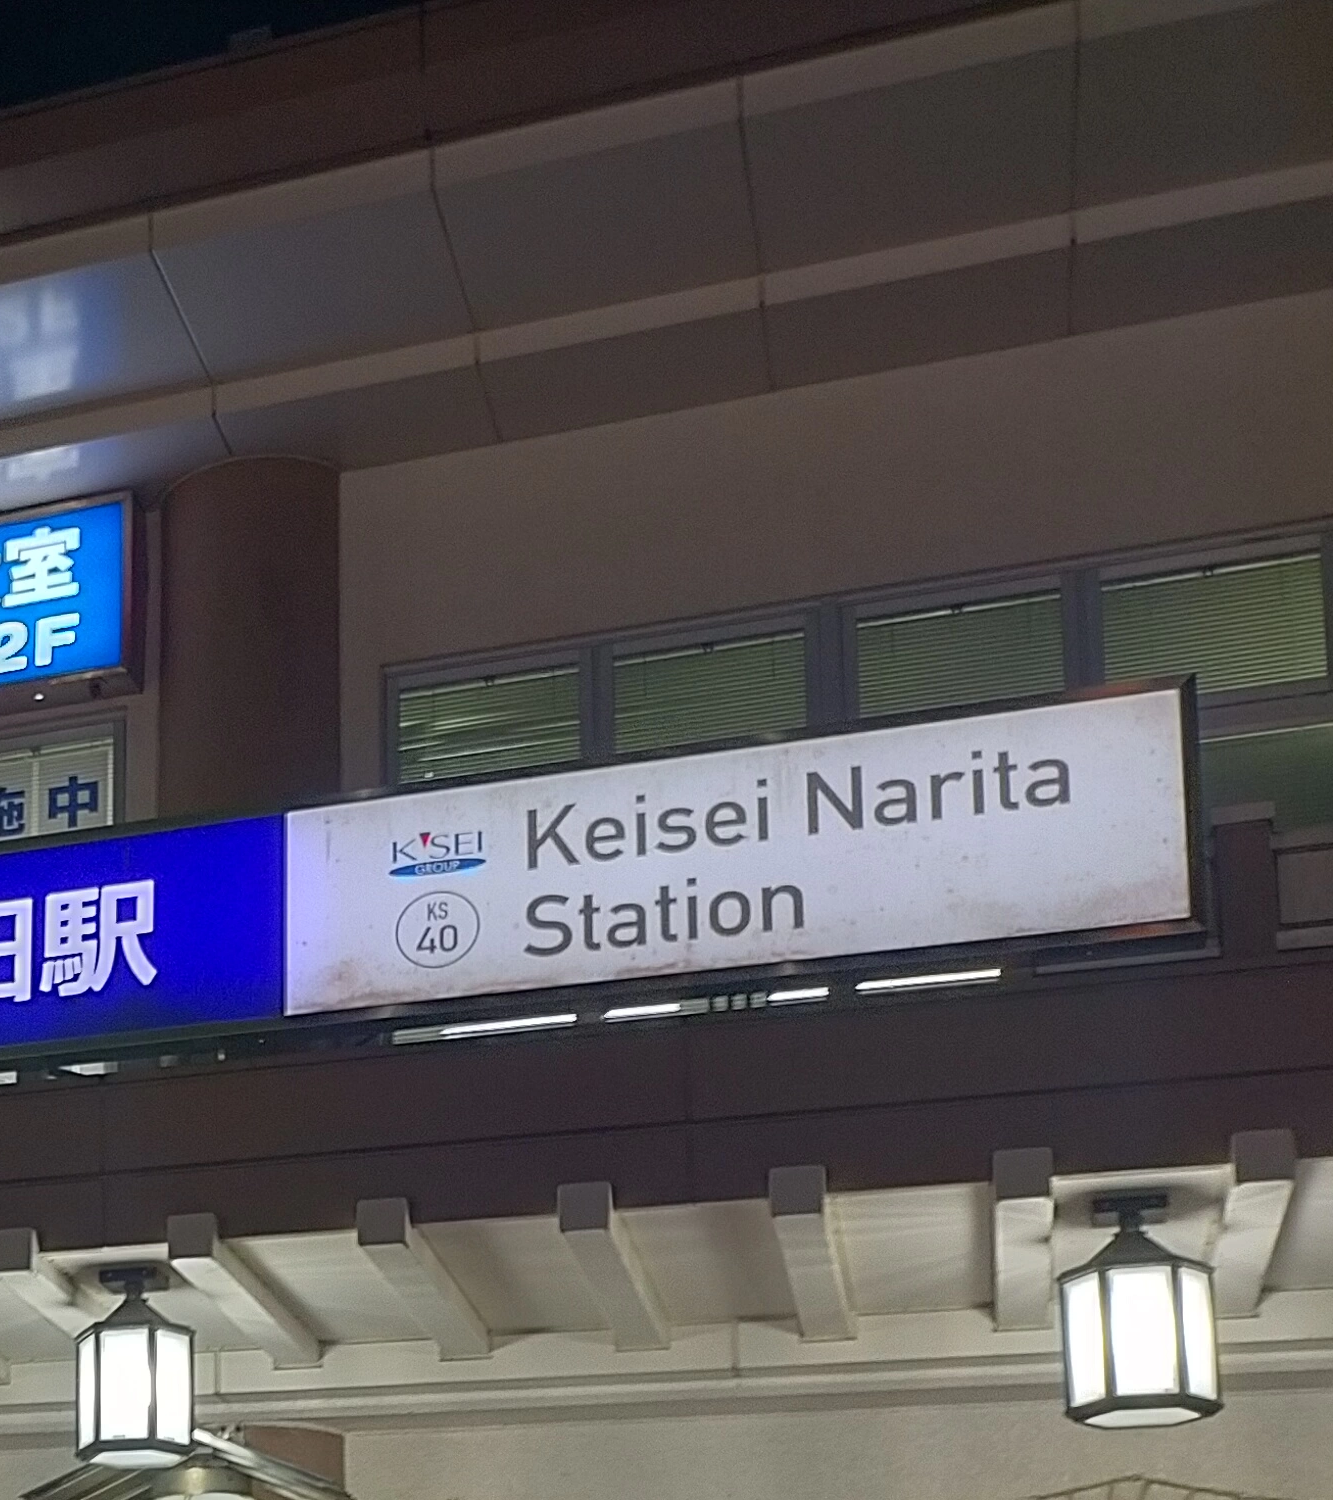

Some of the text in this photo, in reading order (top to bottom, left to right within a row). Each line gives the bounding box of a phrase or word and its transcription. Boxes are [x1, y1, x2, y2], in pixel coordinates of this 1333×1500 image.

[526, 749, 1073, 870] Keisei Narita
[416, 924, 459, 954] 40
[426, 901, 449, 922] KS
[524, 877, 806, 957] Station
